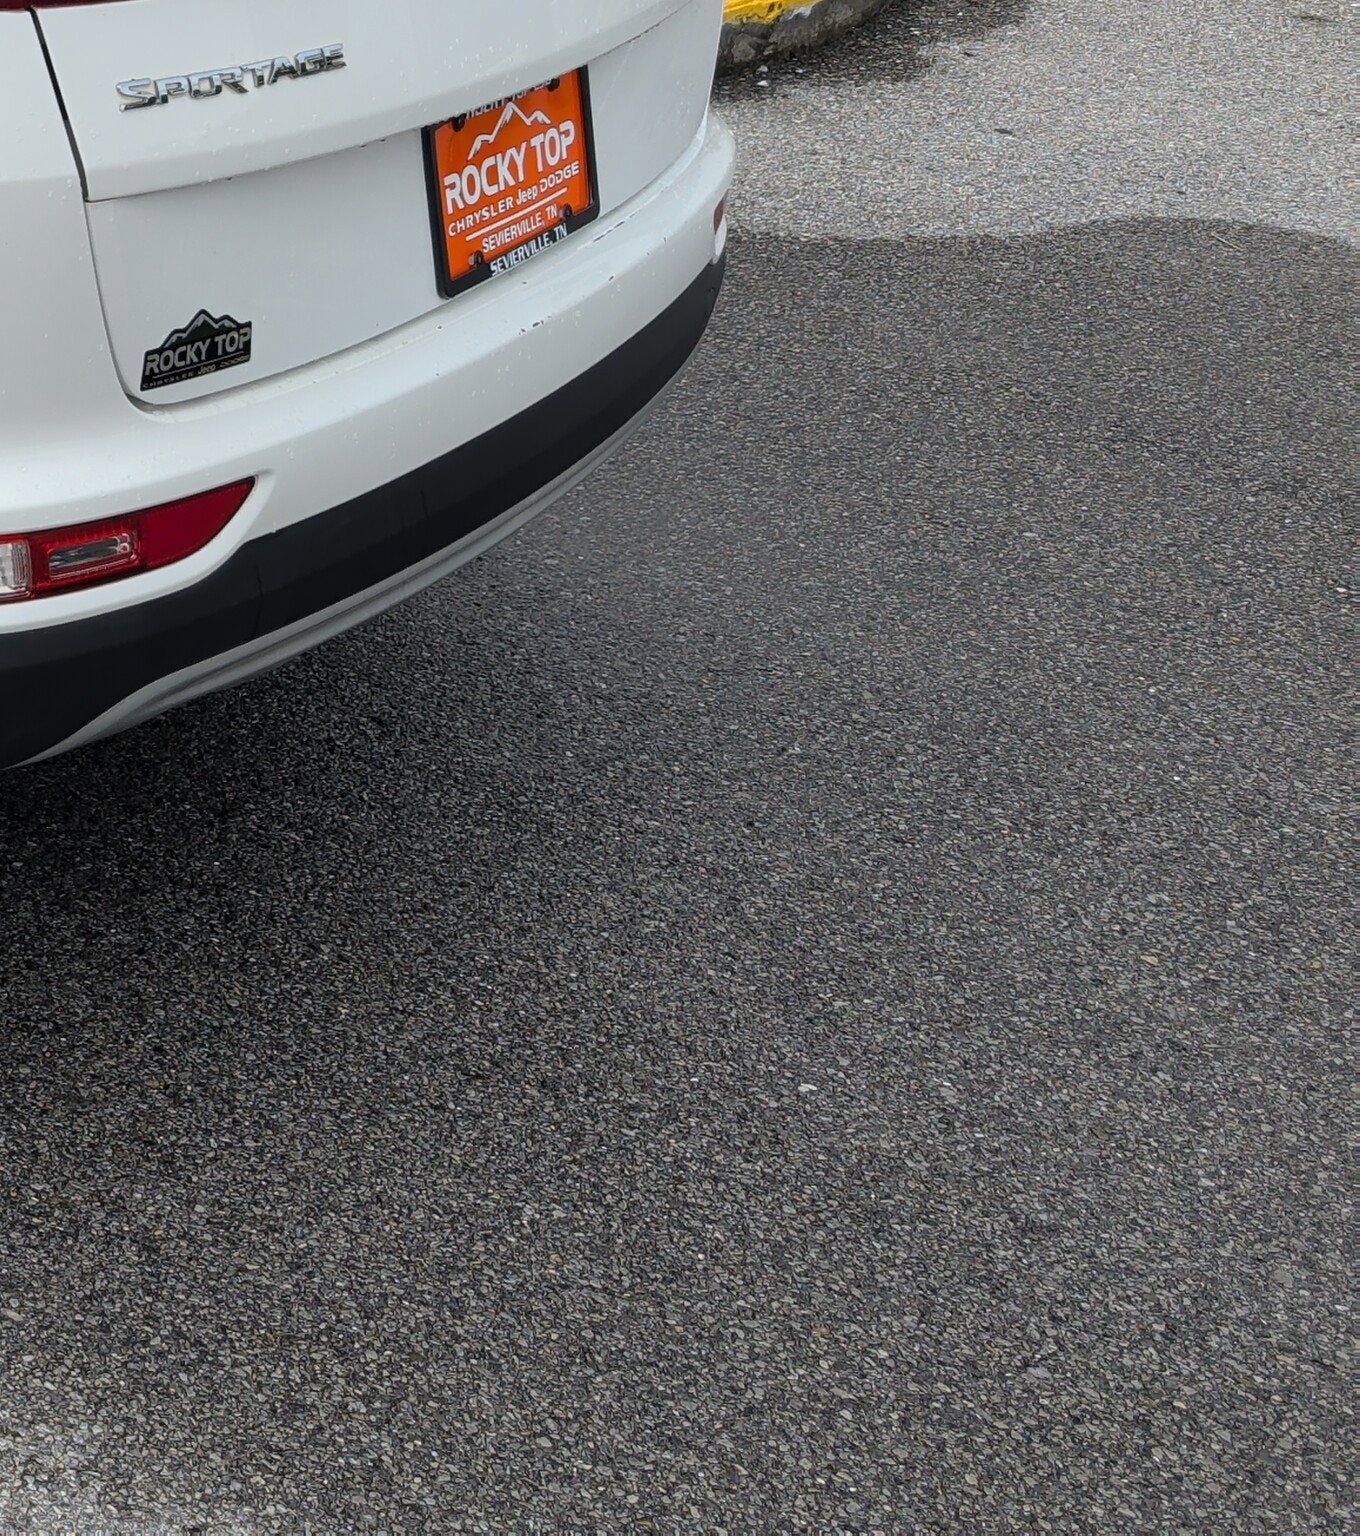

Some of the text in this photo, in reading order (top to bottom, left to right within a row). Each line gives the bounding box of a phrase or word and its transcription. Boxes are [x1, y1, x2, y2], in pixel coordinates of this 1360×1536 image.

[116, 43, 347, 112] SPORTAGE
[444, 120, 575, 214] ROCKY TOP
[448, 161, 580, 237] CHRYSLER Jeep DODGE
[482, 204, 558, 254] SEVIERVILLE, TN
[554, 223, 568, 242] TN
[145, 327, 251, 376] ROCKY TOP
